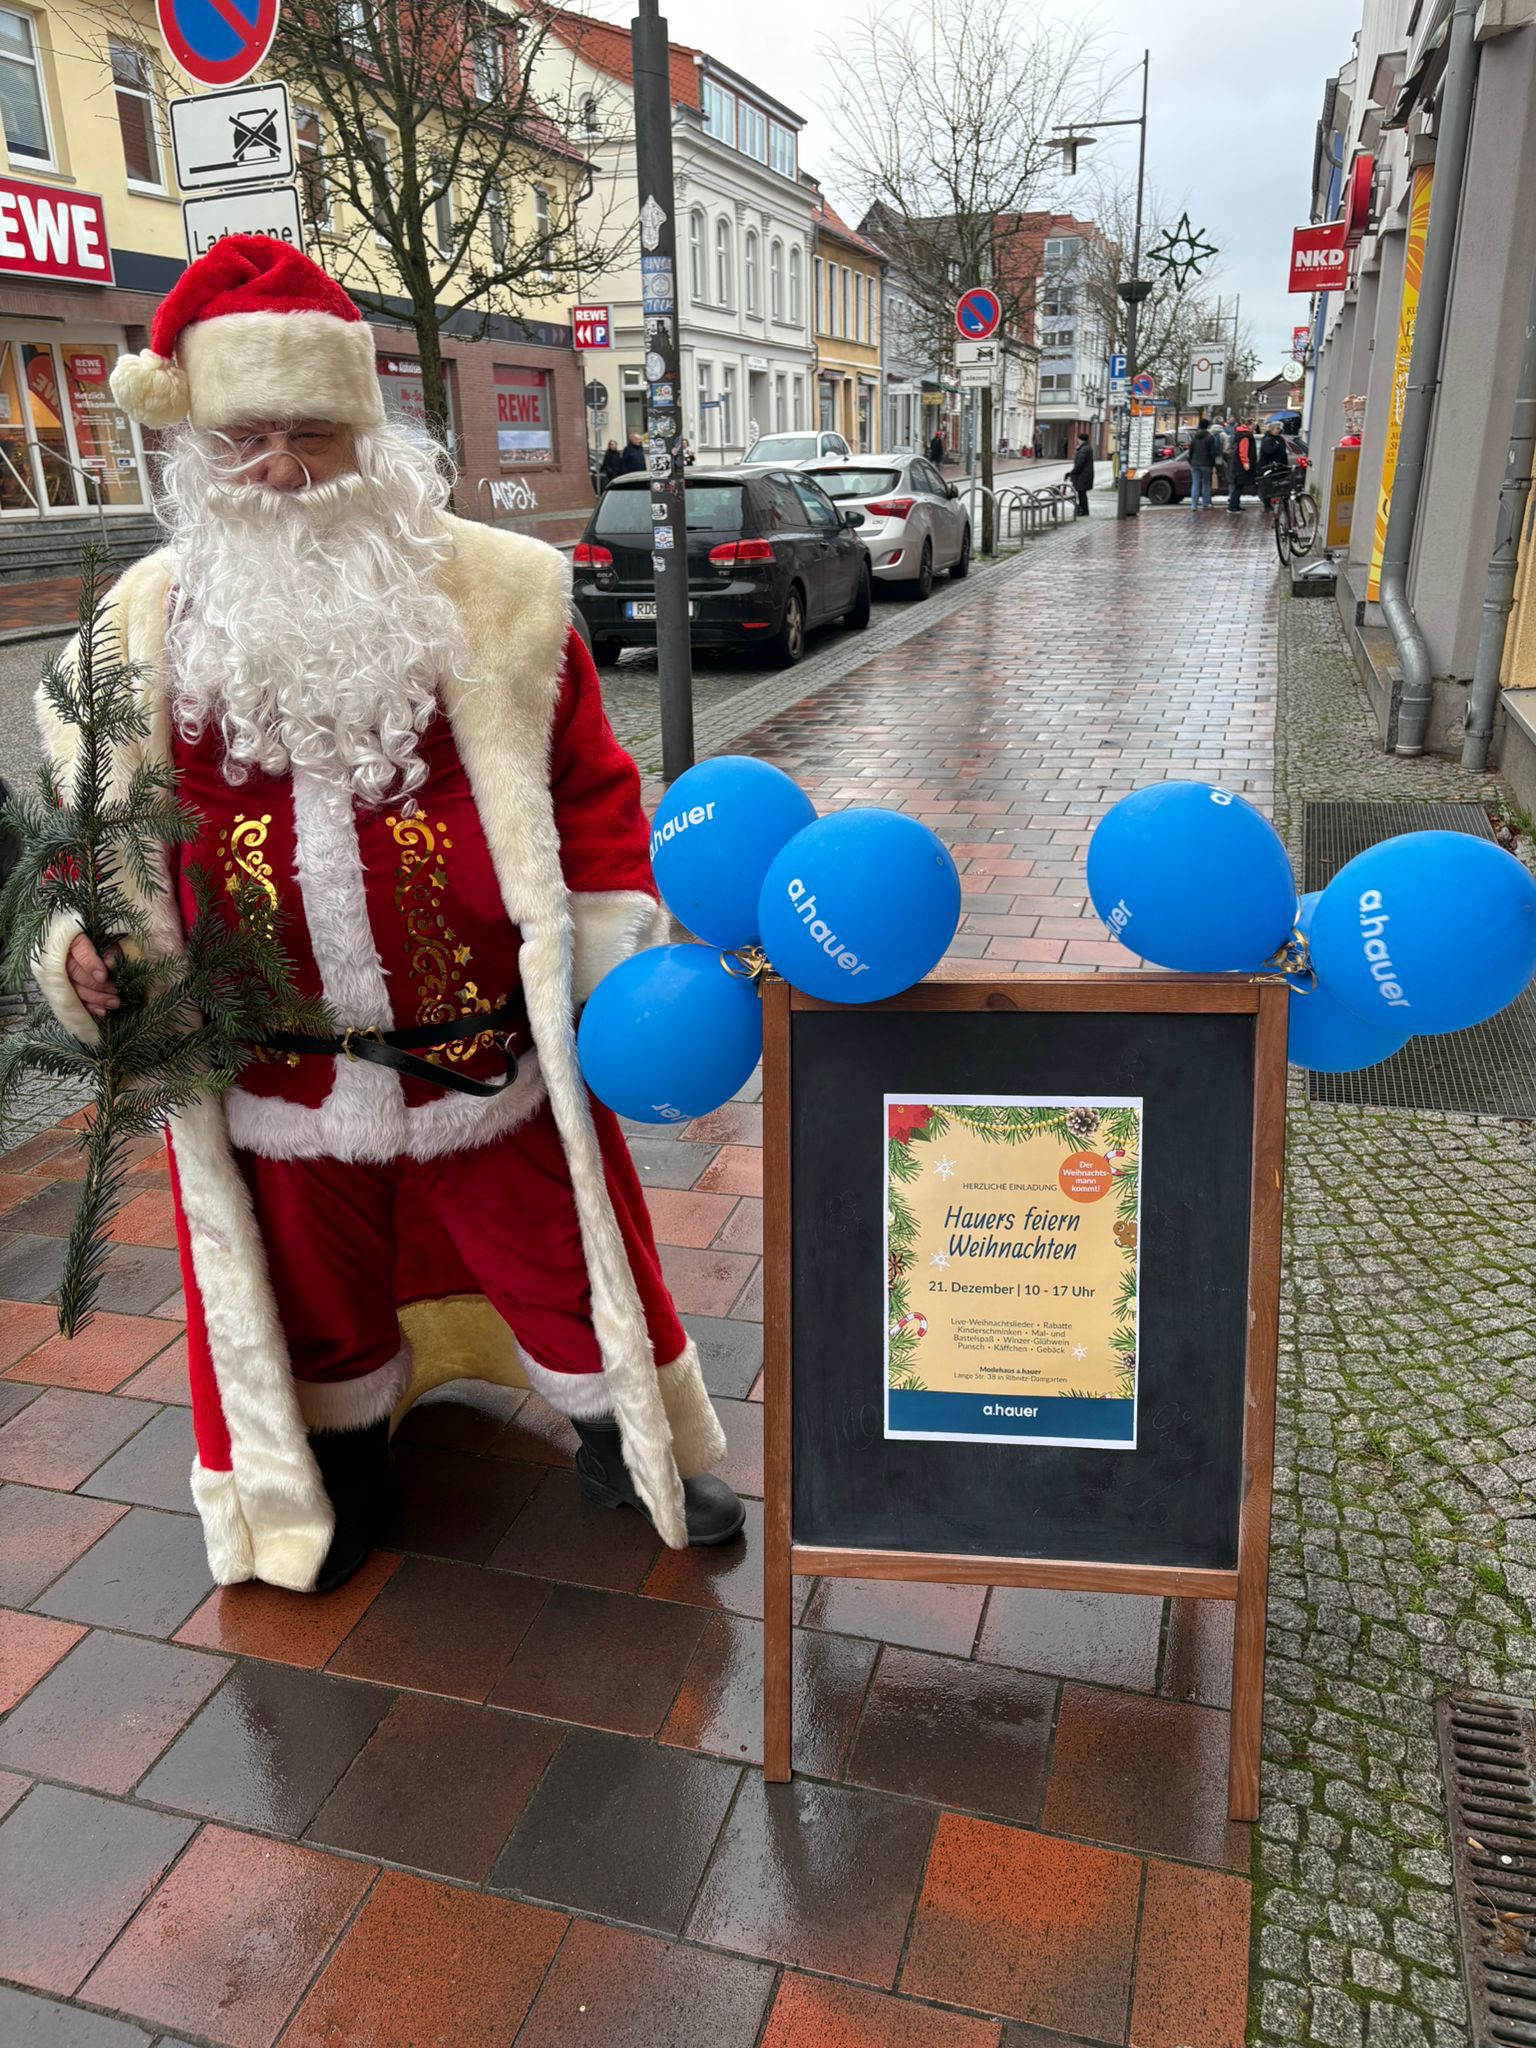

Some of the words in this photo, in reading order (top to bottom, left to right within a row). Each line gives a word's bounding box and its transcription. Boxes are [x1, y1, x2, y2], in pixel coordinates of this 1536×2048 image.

[0, 191, 105, 270] EWE
[194, 227, 293, 255] Lane
[1295, 249, 1344, 267] NKD
[575, 310, 607, 321] REWE
[595, 326, 606, 342] P
[1115, 357, 1127, 377] P
[497, 394, 541, 422] REWE
[787, 877, 870, 978] a.hauer
[1358, 888, 1412, 1008] a.hauer
[1079, 1161, 1094, 1169] Der
[1062, 1168, 1110, 1177] Weihnachts-
[962, 1182, 1007, 1191] HERZLICHE
[1009, 1183, 1058, 1192] EINLADUNG
[1071, 1184, 1100, 1193] kommt!
[944, 1205, 1016, 1231] Hauers
[1023, 1206, 1081, 1232] feiern
[948, 1233, 1077, 1261] Weihnachten
[928, 1280, 948, 1292] 21.
[951, 1281, 1014, 1295] Dezember
[1024, 1284, 1041, 1296] 10
[1052, 1285, 1068, 1297] 17
[1071, 1286, 1096, 1298] Uhr
[951, 1318, 1034, 1329] Live-Weihnachtslieder
[1043, 1322, 1073, 1330] Rabatte
[957, 1326, 1022, 1336] Kinderschminken
[1031, 1329, 1049, 1337] Mal-
[1051, 1330, 1066, 1338] und
[953, 1334, 994, 1344] Bastelspaß
[1003, 1336, 1070, 1346] Winzer-Glühwein
[957, 1342, 985, 1350] Punsch
[994, 1343, 1028, 1352] Käffchen
[1036, 1345, 1065, 1354] Gebäck
[953, 1372, 973, 1380] Lange
[987, 1373, 996, 1381] 38
[979, 1366, 1015, 1374] Modehaus
[982, 1404, 1039, 1418] a.hauer
